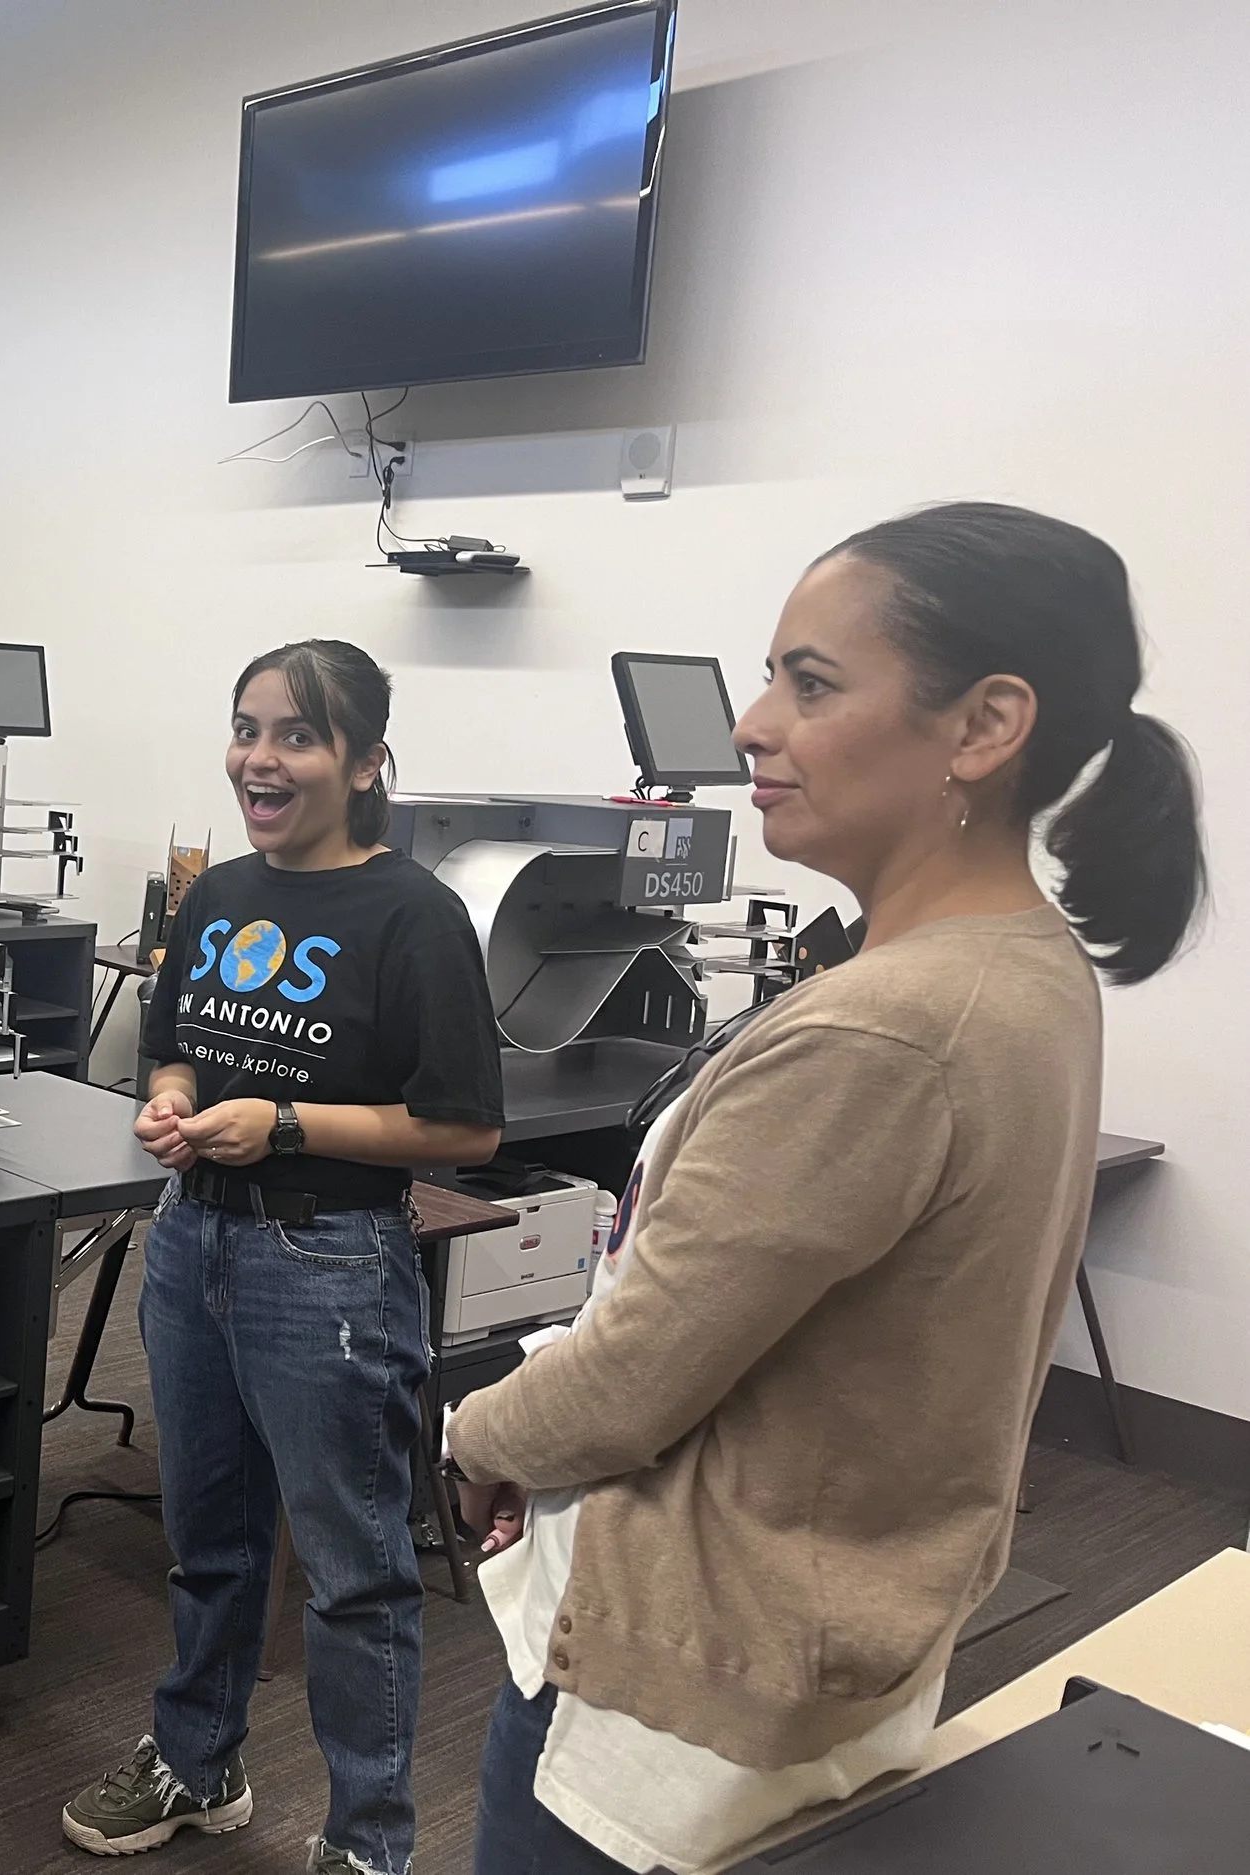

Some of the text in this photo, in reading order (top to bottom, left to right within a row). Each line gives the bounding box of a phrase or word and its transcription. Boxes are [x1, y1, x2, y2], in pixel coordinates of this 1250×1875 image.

[638, 831, 649, 852] C
[644, 872, 703, 898] DS450
[189, 918, 342, 1003] SOS
[200, 997, 333, 1044] ANTONIO
